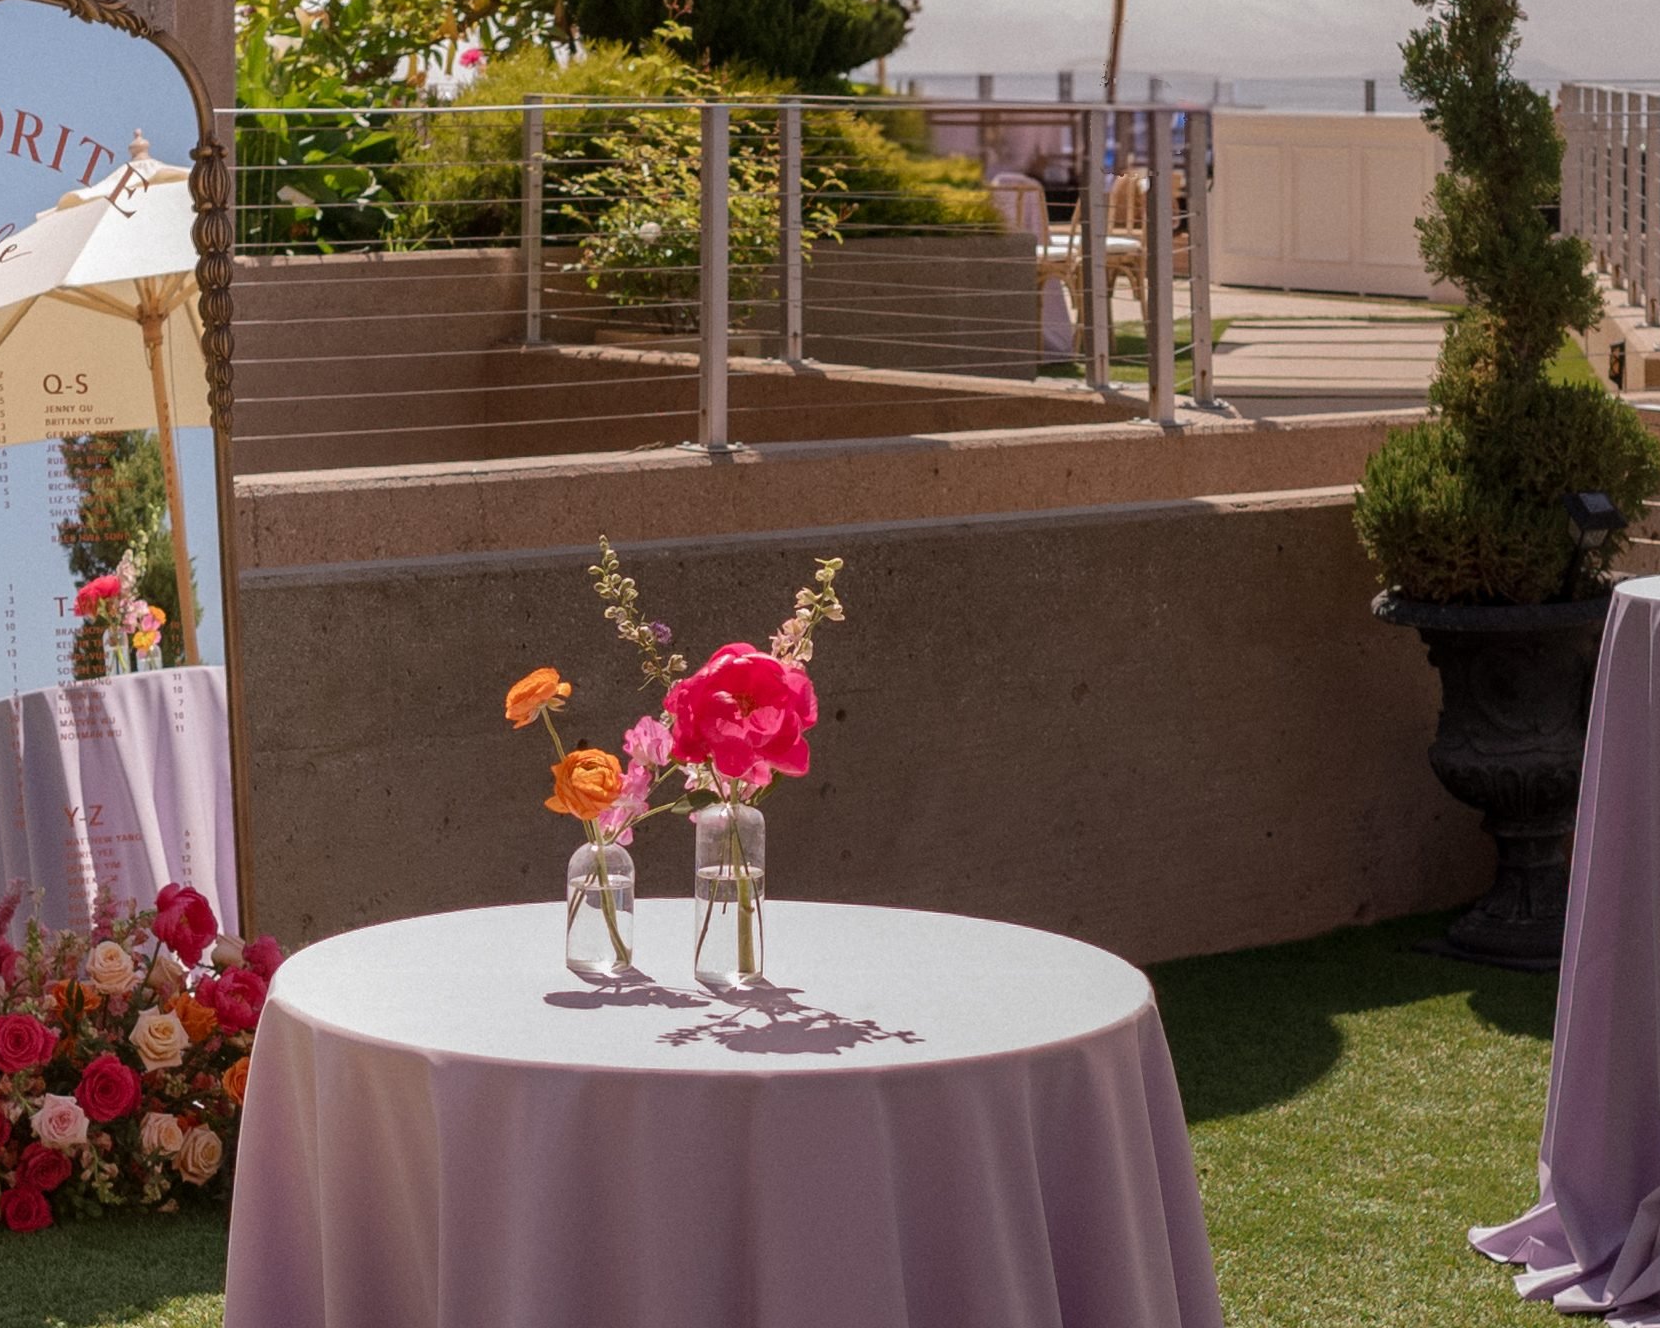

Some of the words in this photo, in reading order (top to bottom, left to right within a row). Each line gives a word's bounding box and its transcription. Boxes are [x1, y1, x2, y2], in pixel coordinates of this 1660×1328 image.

[0, 384, 3, 392] 5
[43, 374, 89, 395] Q-S
[44, 404, 75, 414] JENNY
[45, 418, 91, 426] BRITTANY
[0, 475, 8, 483] 13
[4, 488, 9, 496] 5
[5, 610, 15, 618] 12
[5, 623, 15, 631] 10
[10, 636, 16, 644] 2
[7, 649, 17, 657] 13
[64, 805, 103, 827] Y-Z
